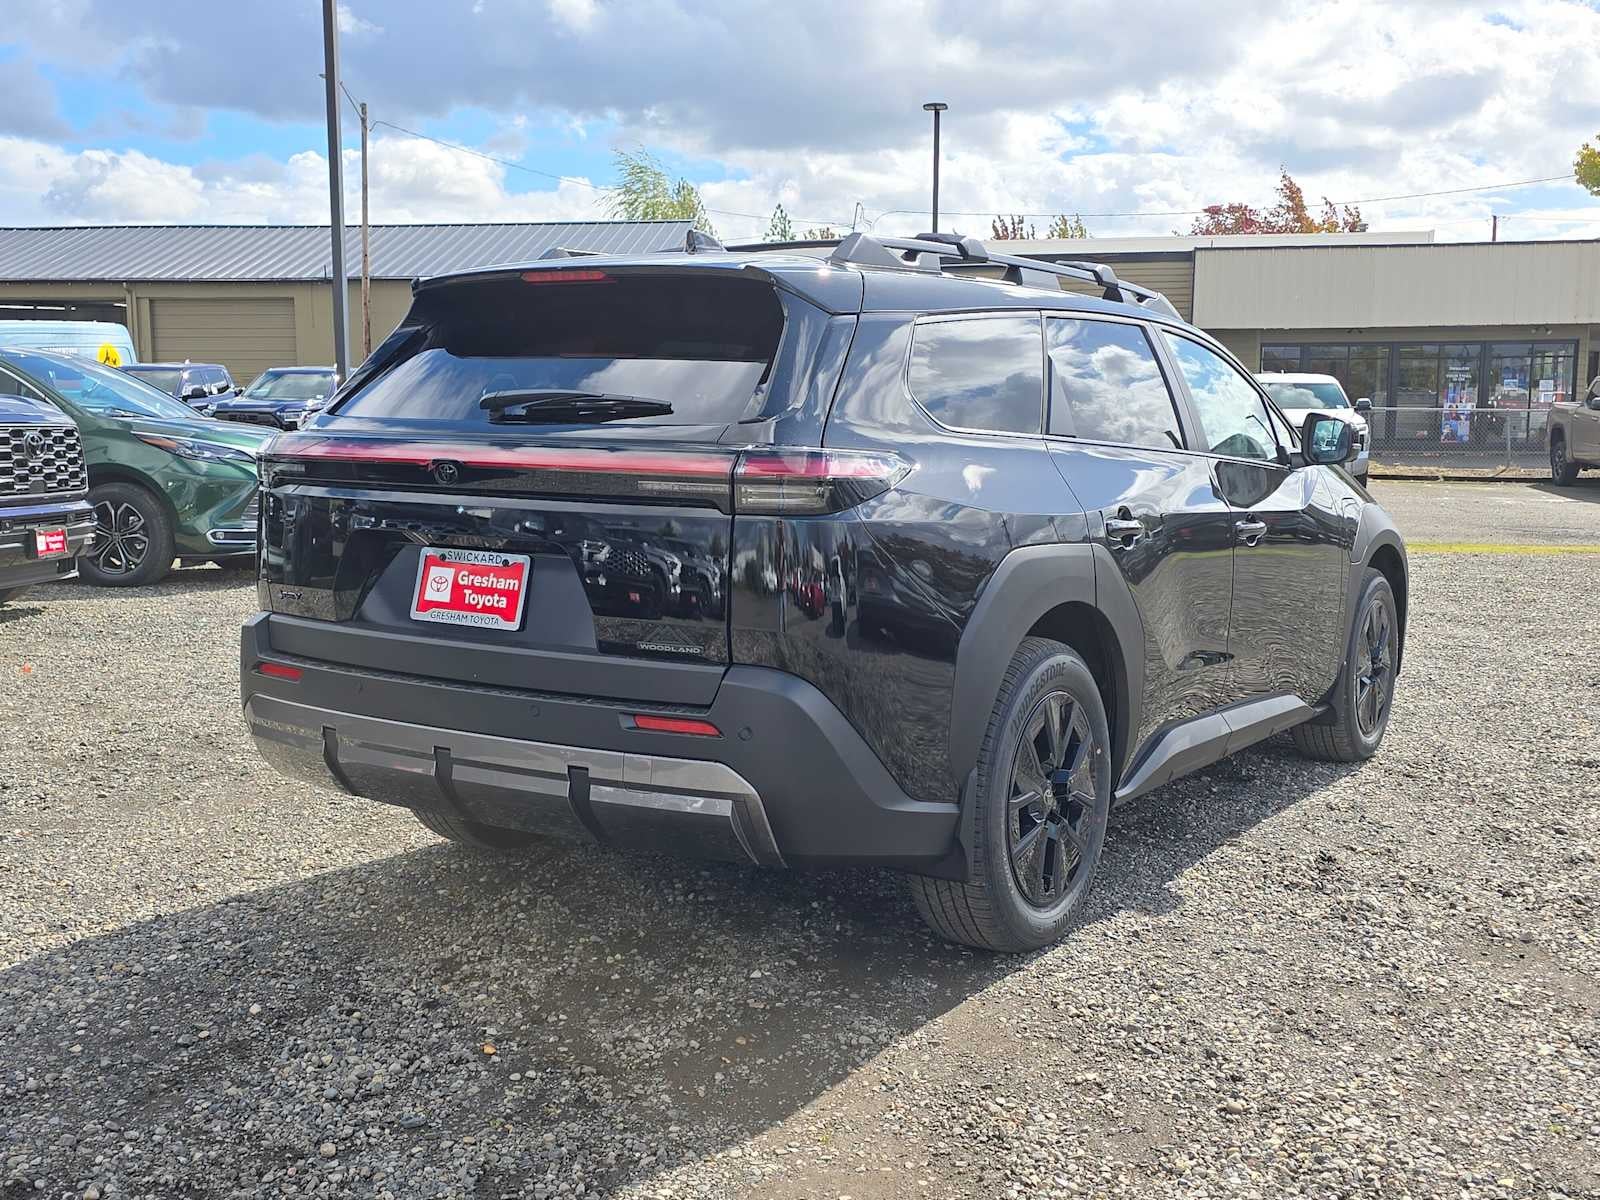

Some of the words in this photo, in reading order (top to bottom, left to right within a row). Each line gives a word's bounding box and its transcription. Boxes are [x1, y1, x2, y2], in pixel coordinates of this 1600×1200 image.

[447, 550, 502, 564] SWICKARD
[458, 570, 519, 590] Gresham
[464, 589, 507, 609] Toyota
[430, 611, 468, 622] GRESHAM
[470, 616, 499, 625] TOYOTA
[640, 643, 701, 654] WOODLAND
